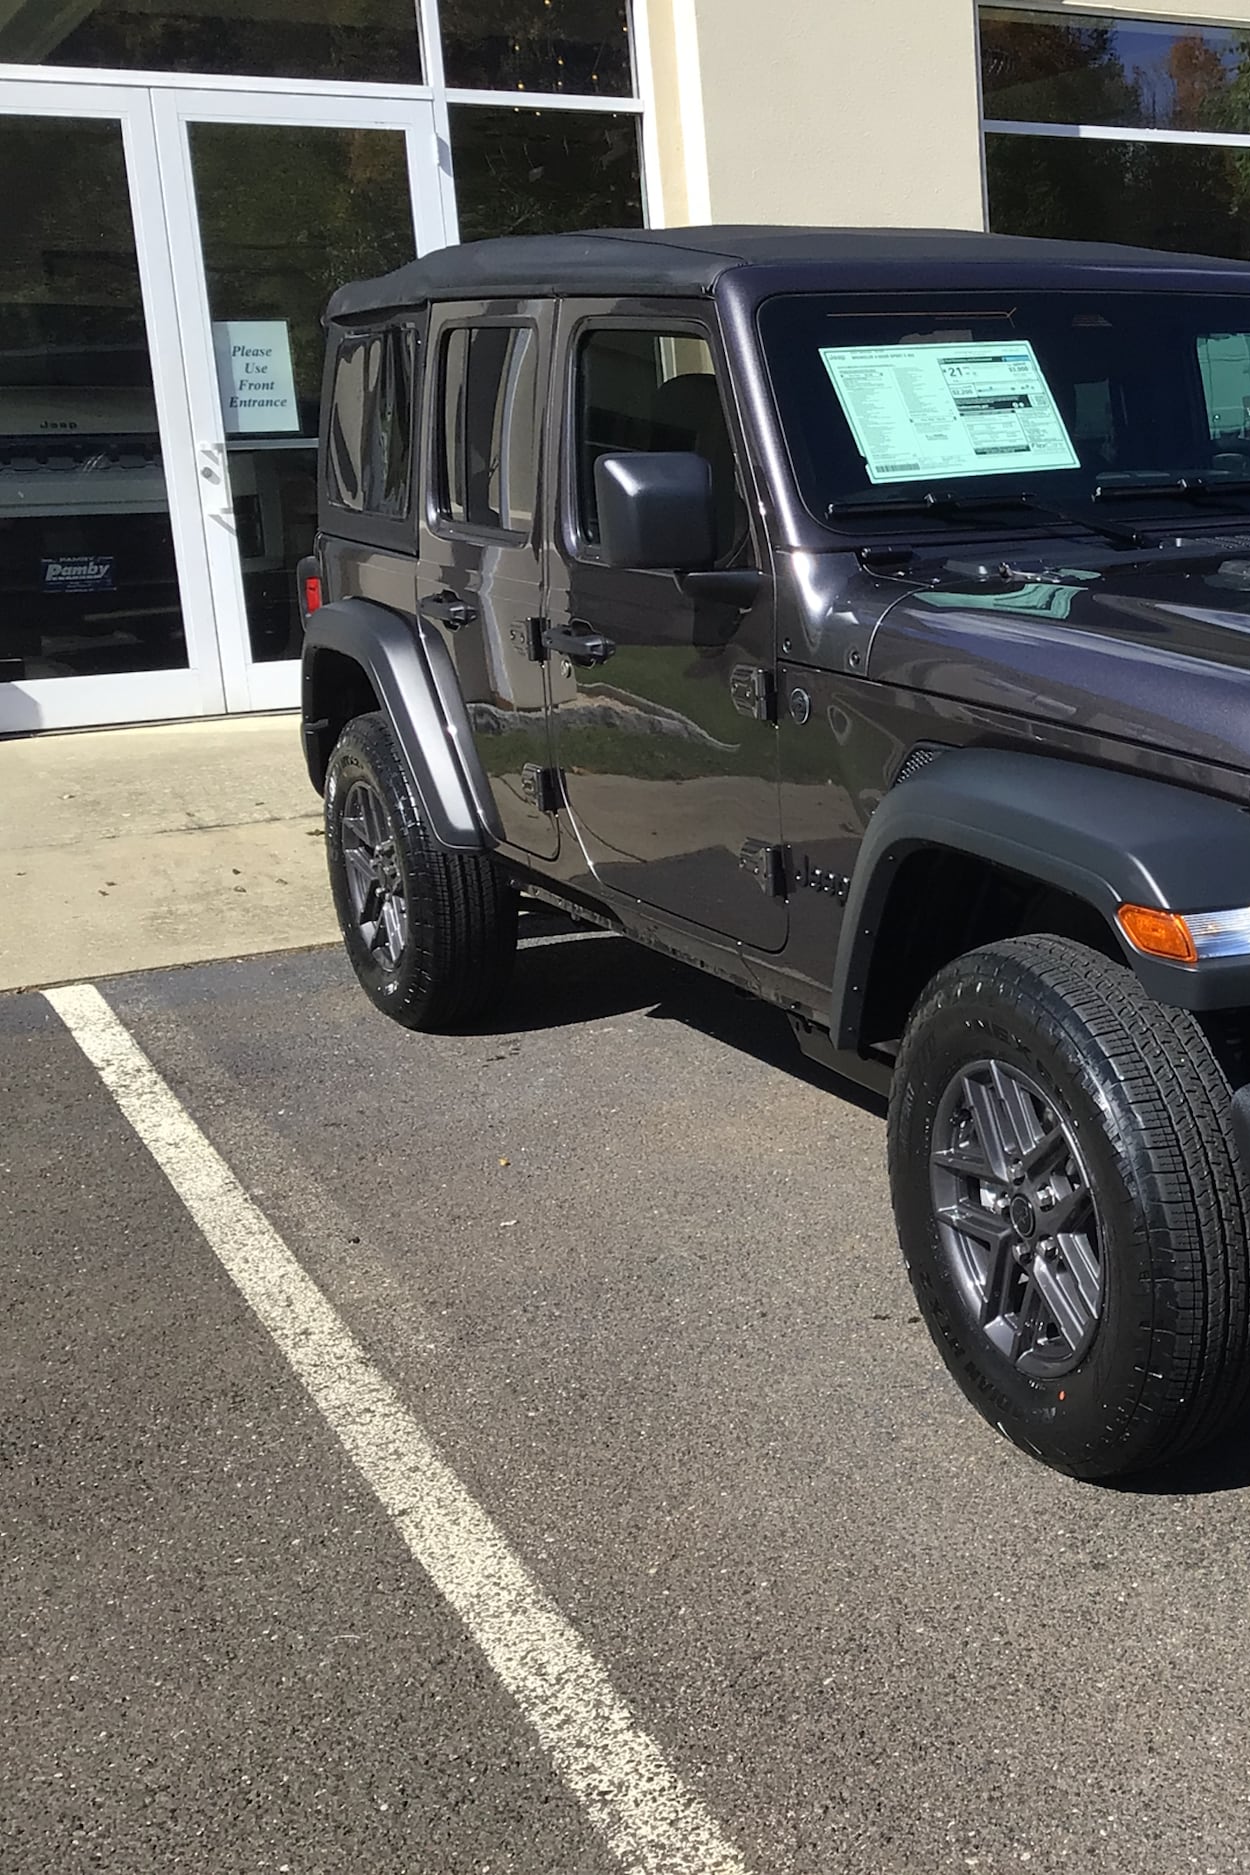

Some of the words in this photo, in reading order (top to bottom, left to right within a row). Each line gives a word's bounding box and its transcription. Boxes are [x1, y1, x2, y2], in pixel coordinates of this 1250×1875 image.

[231, 346, 272, 357] Please
[244, 363, 268, 374] Use
[239, 379, 275, 391] Front
[228, 397, 287, 408] Entrance
[40, 420, 78, 431] Jeep
[45, 562, 110, 582] Pamby
